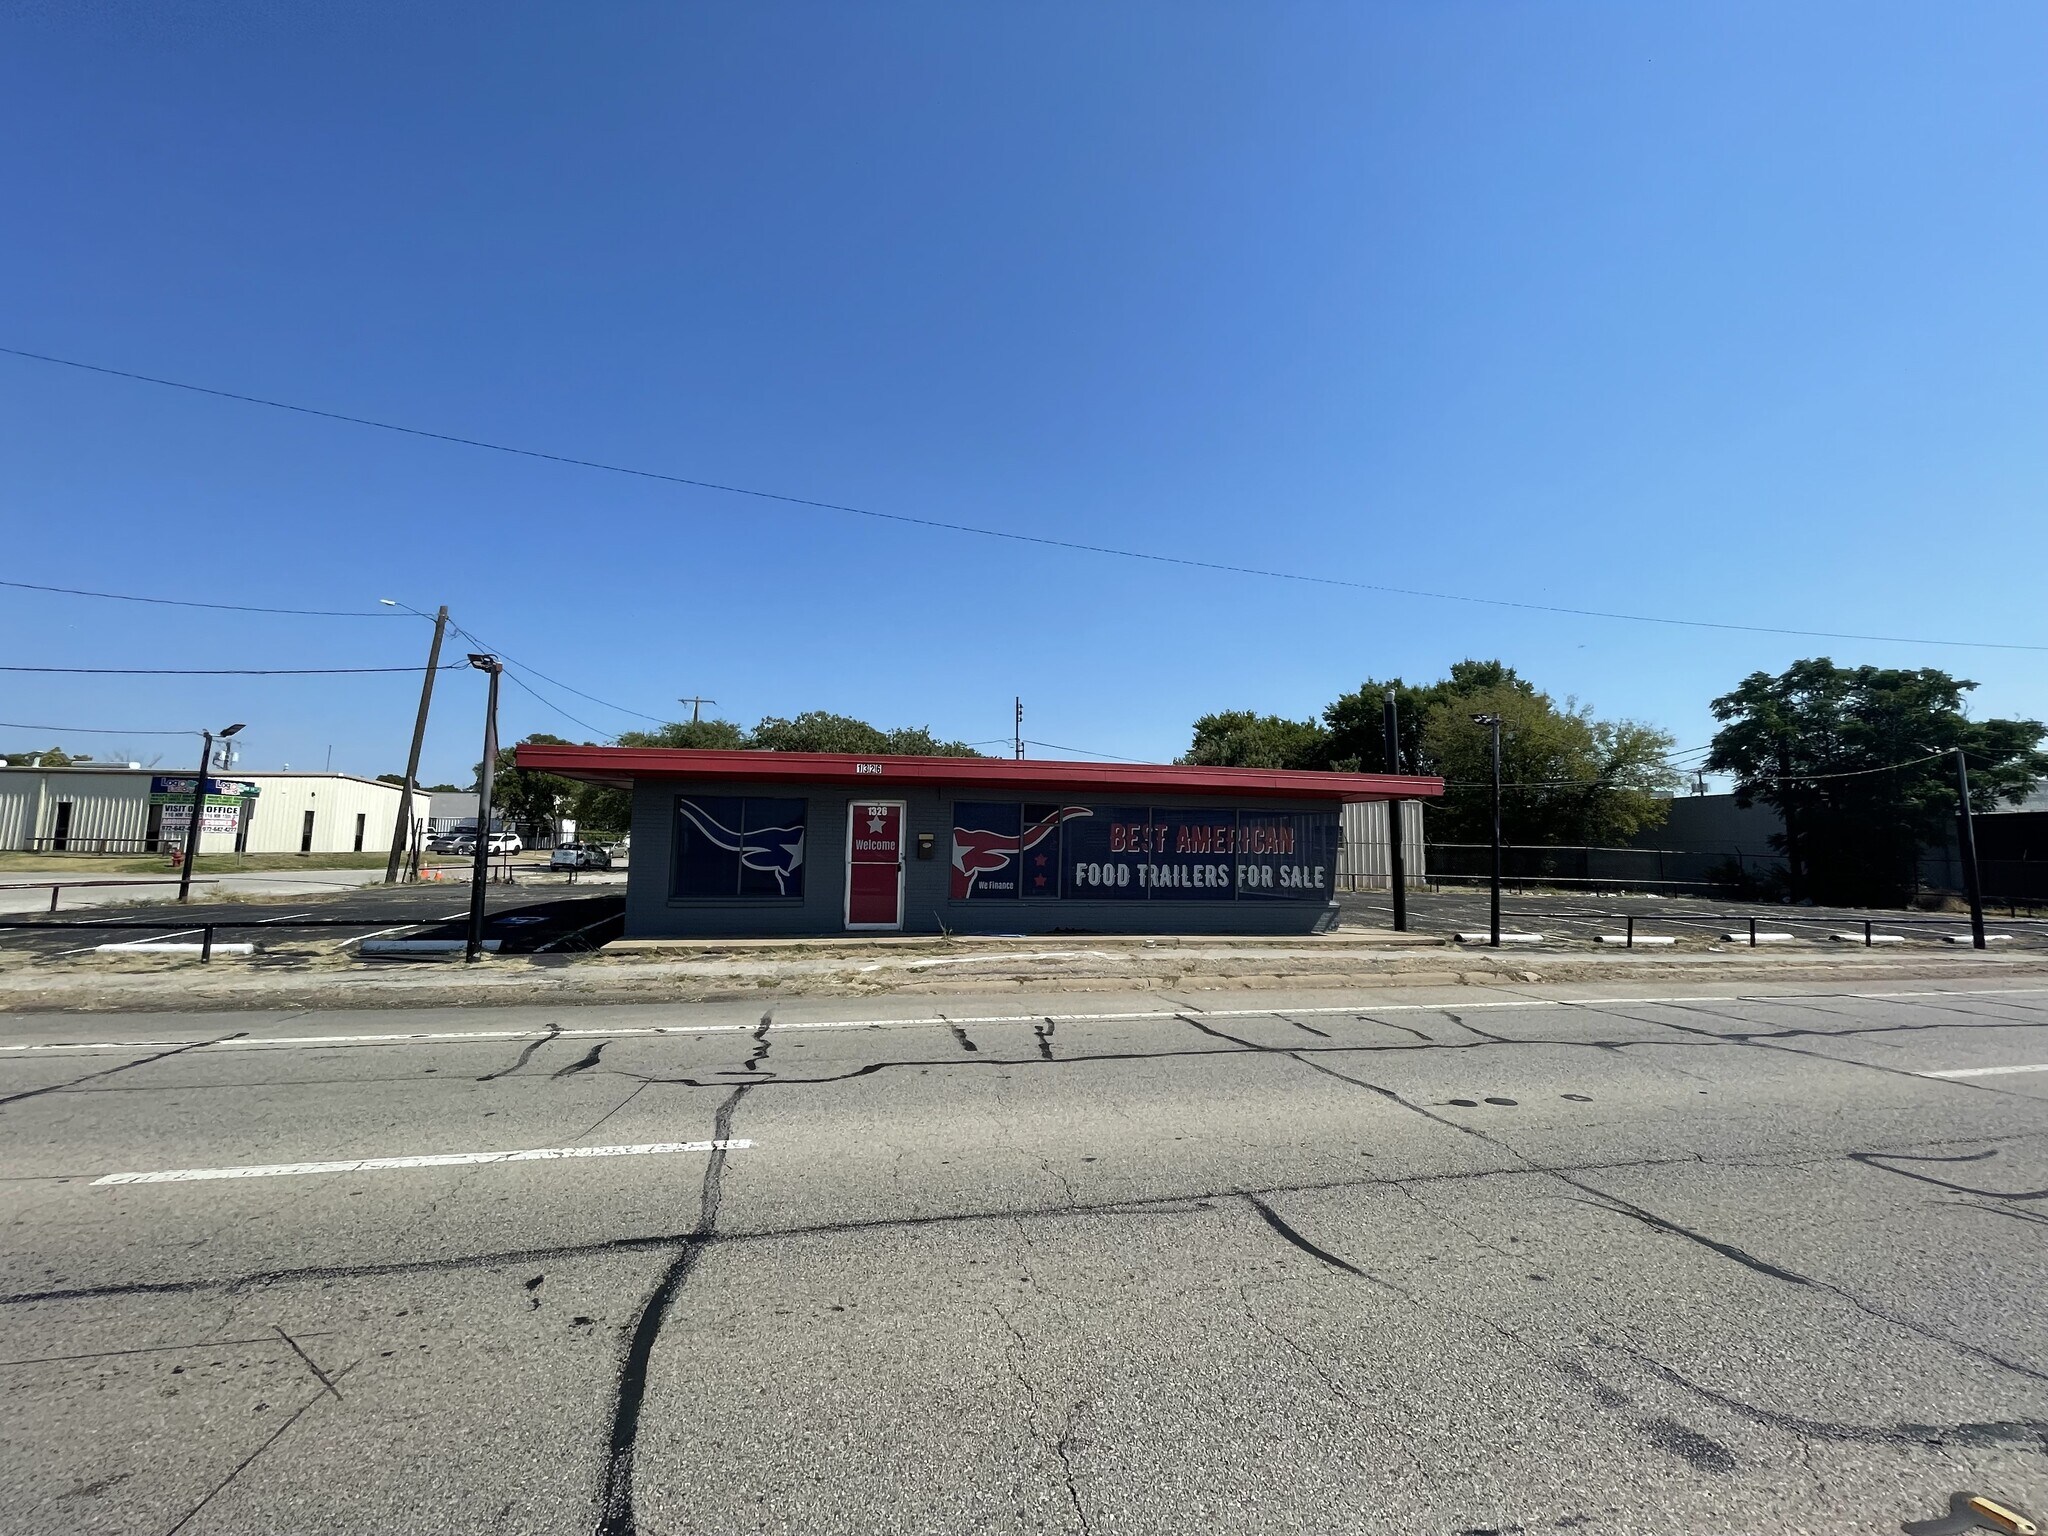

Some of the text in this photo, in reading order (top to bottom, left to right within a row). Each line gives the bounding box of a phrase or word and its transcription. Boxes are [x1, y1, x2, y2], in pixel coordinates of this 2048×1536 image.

[857, 764, 882, 774] 1326
[165, 804, 186, 813] VISIT
[206, 806, 238, 814] OFFICE
[867, 807, 888, 816] 1326
[1109, 823, 1295, 854] BEST AMERICAN
[855, 839, 896, 851] Welcome
[1075, 862, 1326, 889] FOOD TRAILERS FOR SALE
[978, 881, 1014, 890] We Finance
